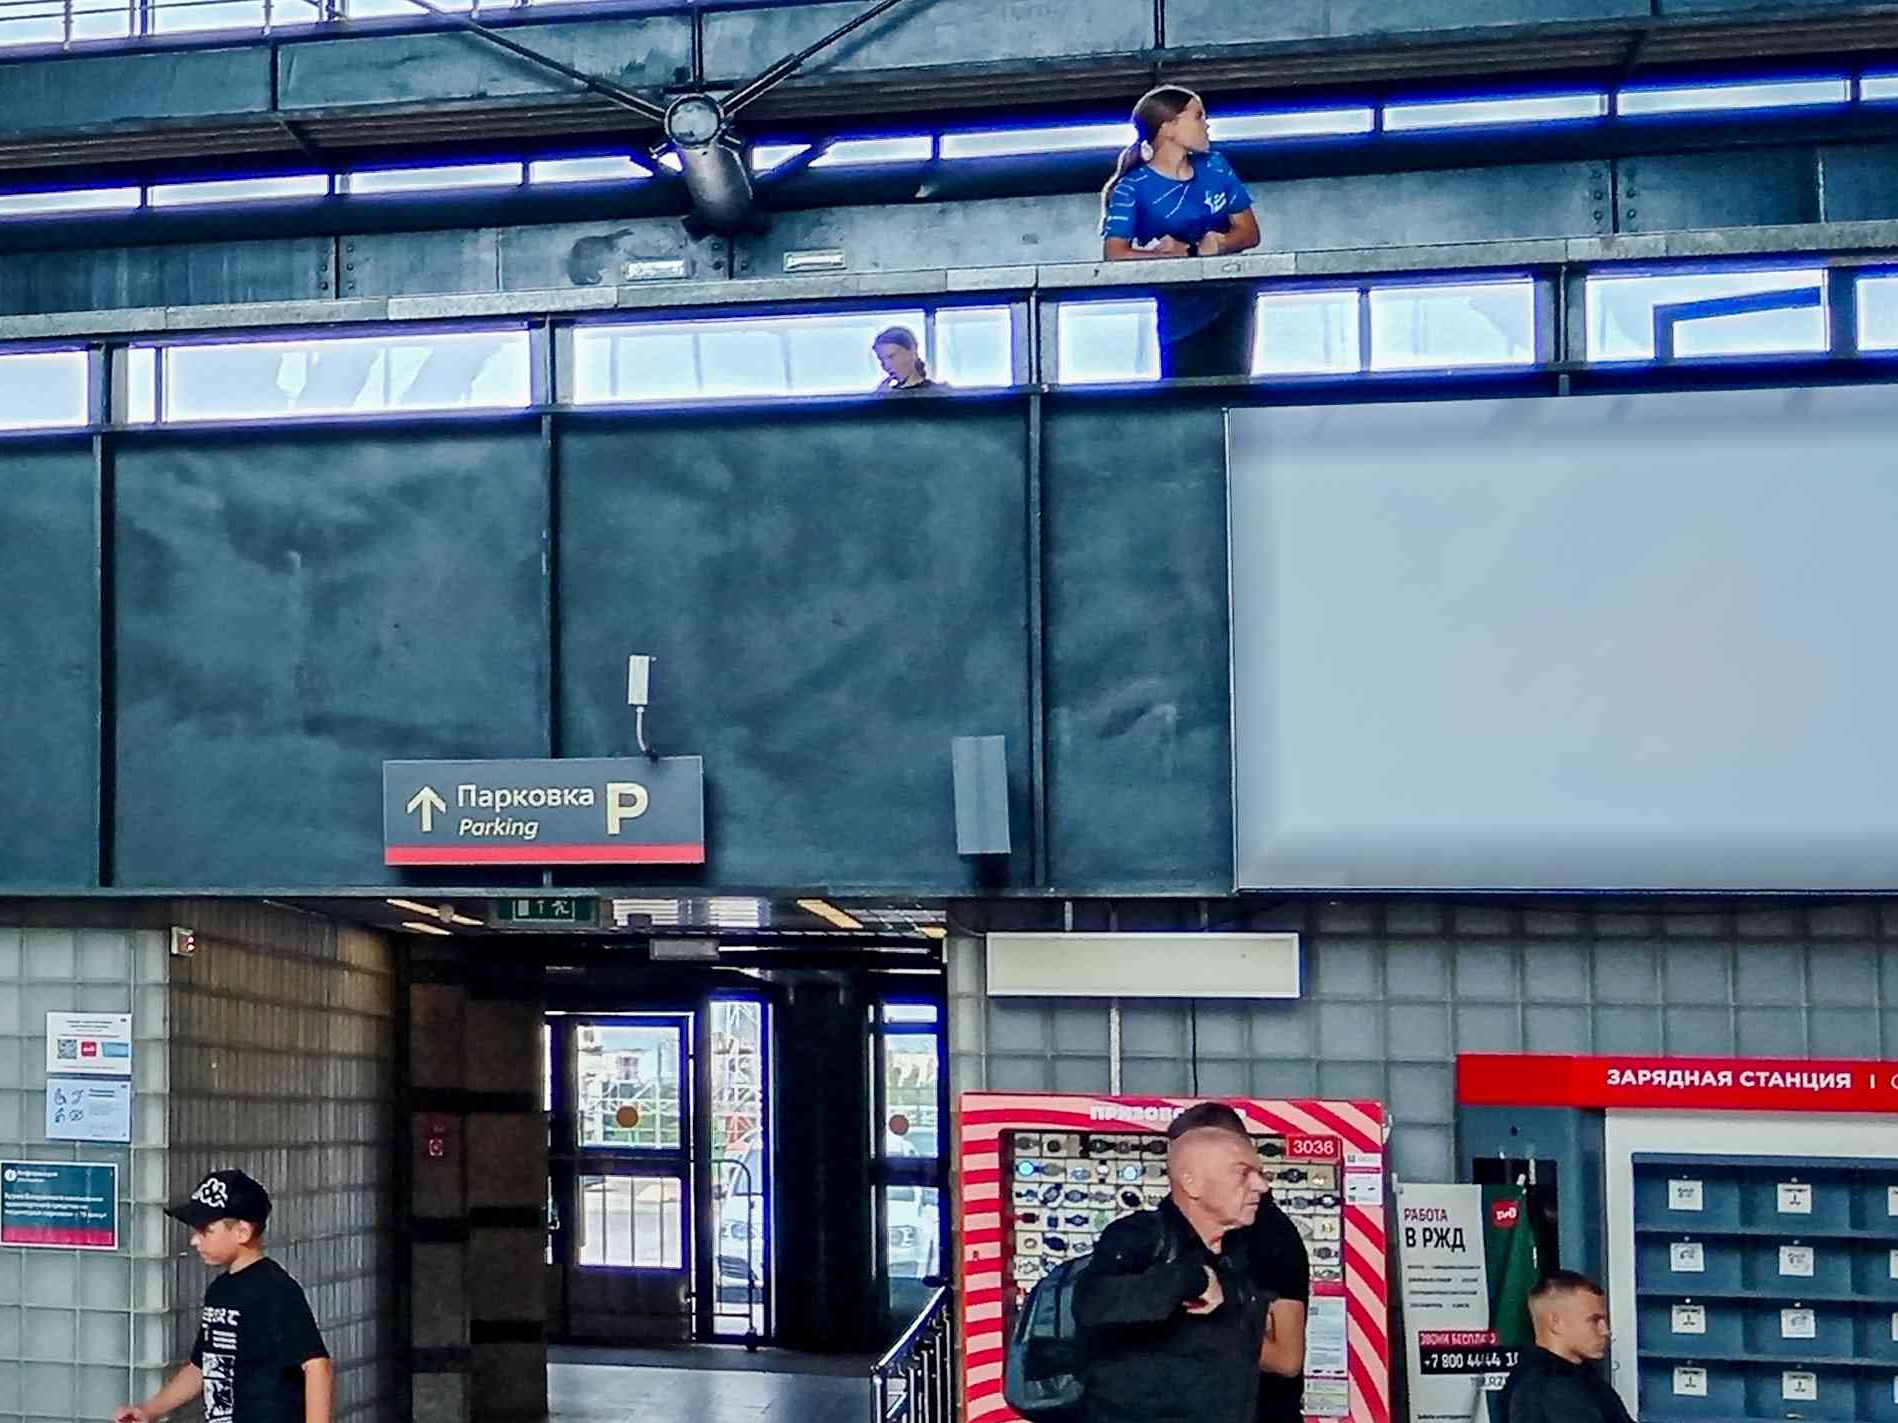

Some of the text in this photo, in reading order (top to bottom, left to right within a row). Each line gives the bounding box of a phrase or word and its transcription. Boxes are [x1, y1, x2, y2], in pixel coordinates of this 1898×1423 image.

[457, 783, 595, 812] Парковка
[459, 817, 540, 841] Parking
[1607, 1069, 1852, 1092] ЗАРЯДНАЯ СТАНЦИЯ
[1404, 1208, 1449, 1223] РАБОТА
[1405, 1227, 1467, 1252] В РЖД
[1441, 1353, 1464, 1368] 800
